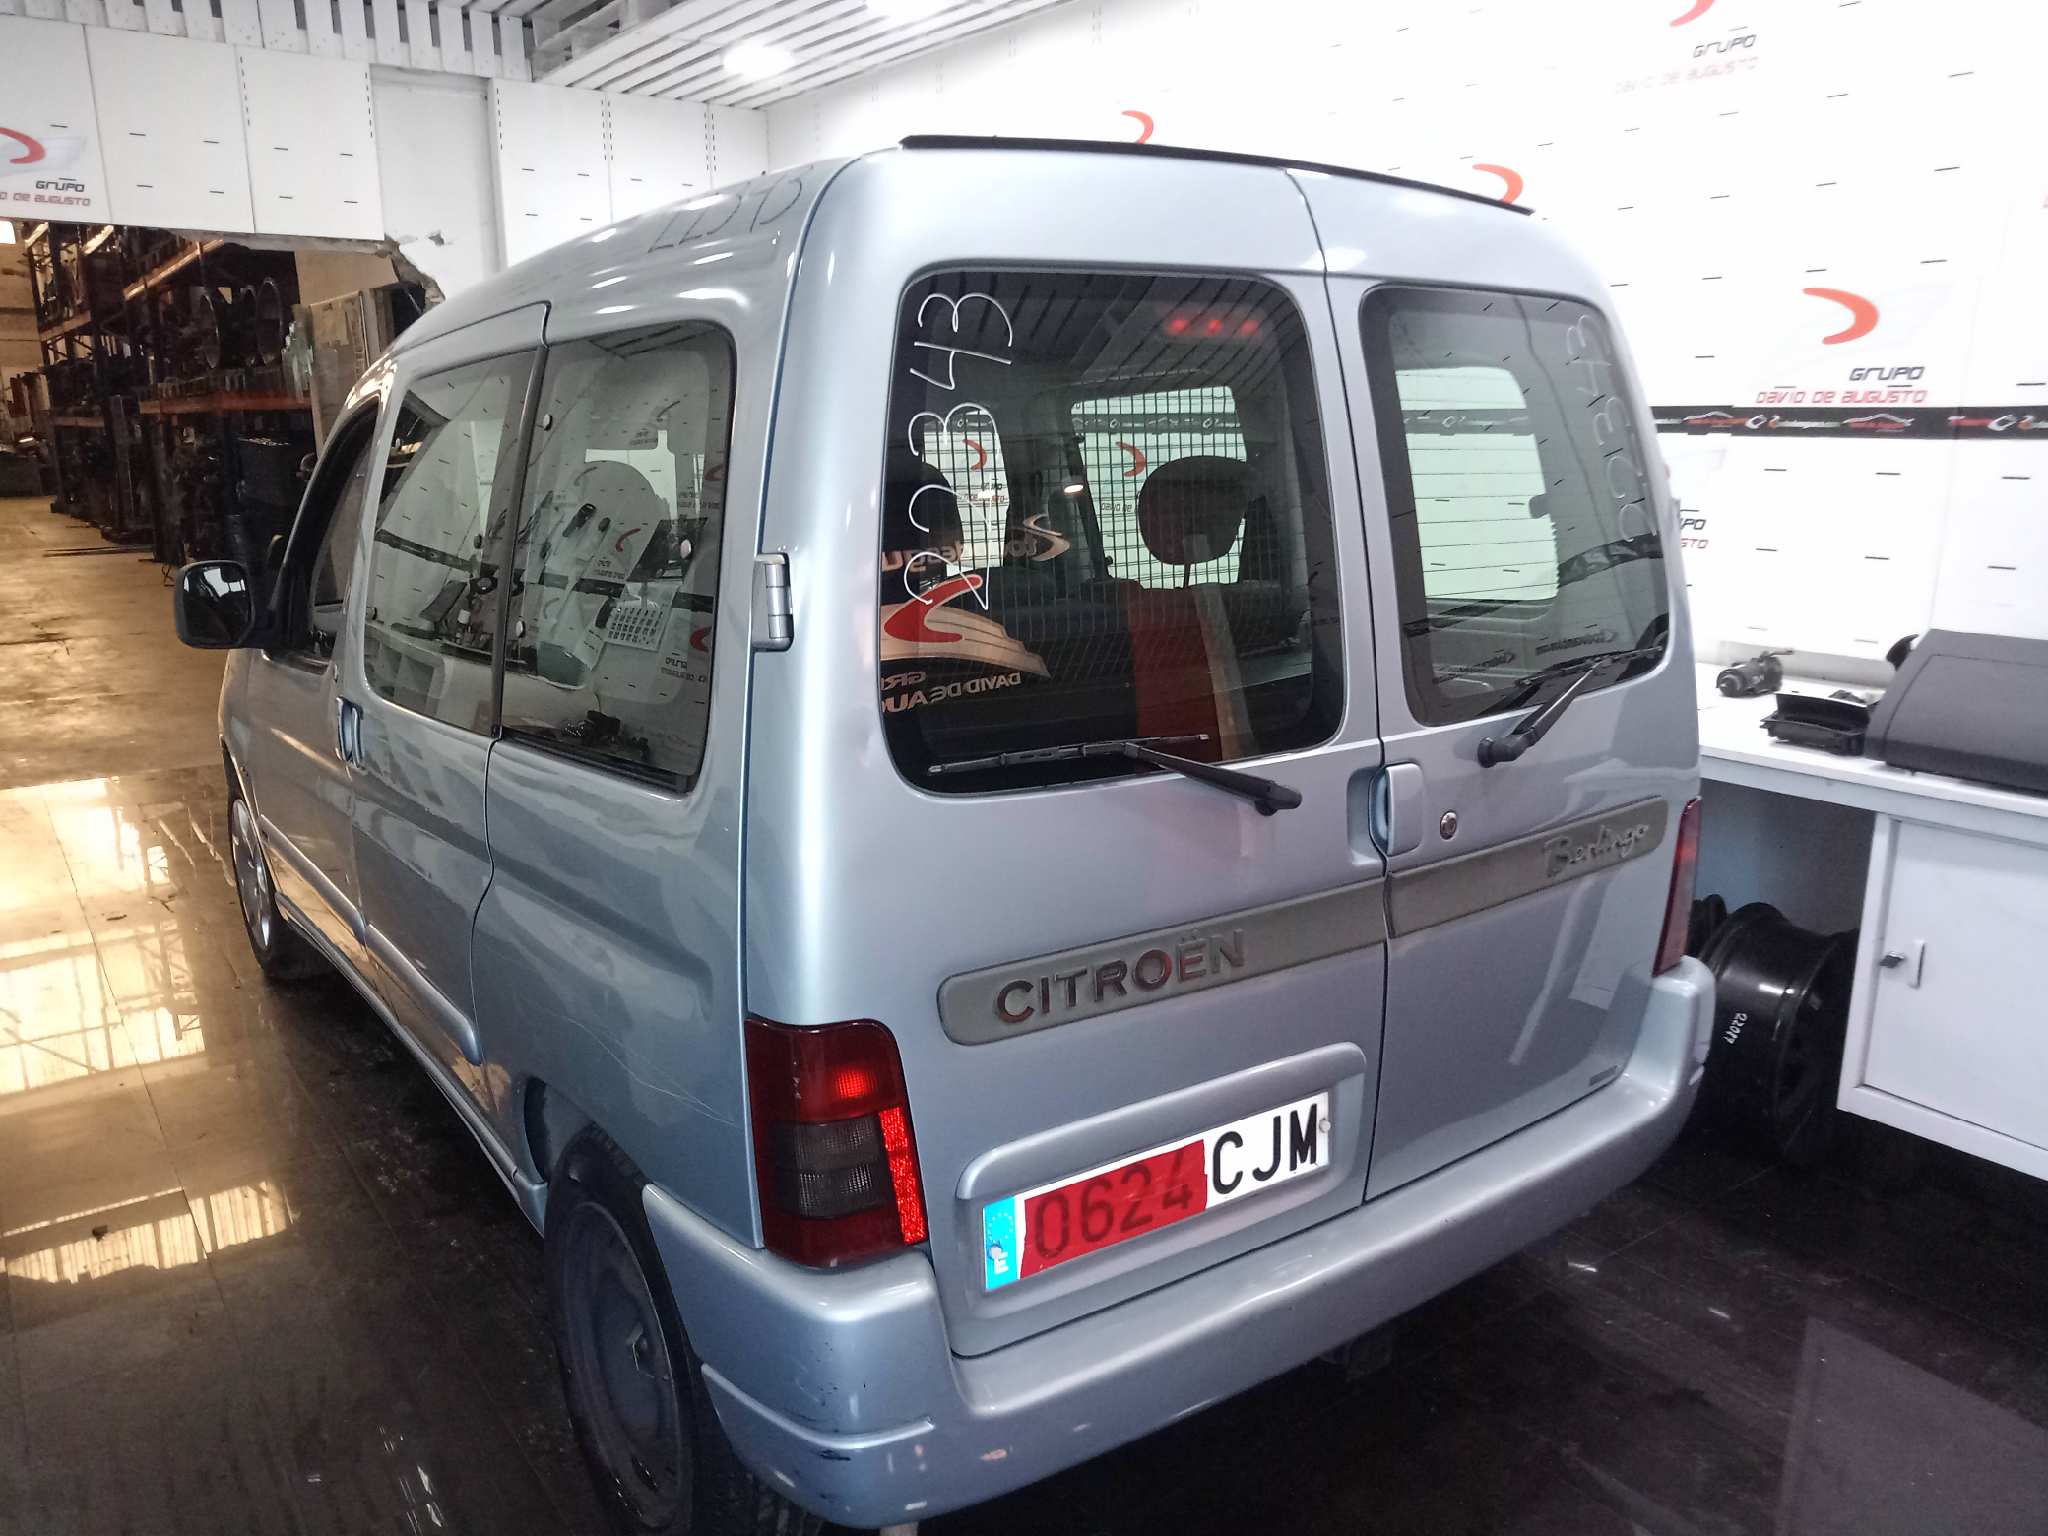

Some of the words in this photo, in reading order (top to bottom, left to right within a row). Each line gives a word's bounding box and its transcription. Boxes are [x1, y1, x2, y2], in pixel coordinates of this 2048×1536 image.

[35, 180, 85, 193] GRUPO
[1849, 366, 1925, 381] GRUPO
[1756, 391, 1806, 404] DAVID
[1811, 391, 1835, 404] DE
[1840, 390, 1929, 404] AUGUSTO
[995, 928, 1245, 1025] CITROËN
[1034, 1148, 1194, 1260] 0624
[1212, 1103, 1318, 1195] CJM
